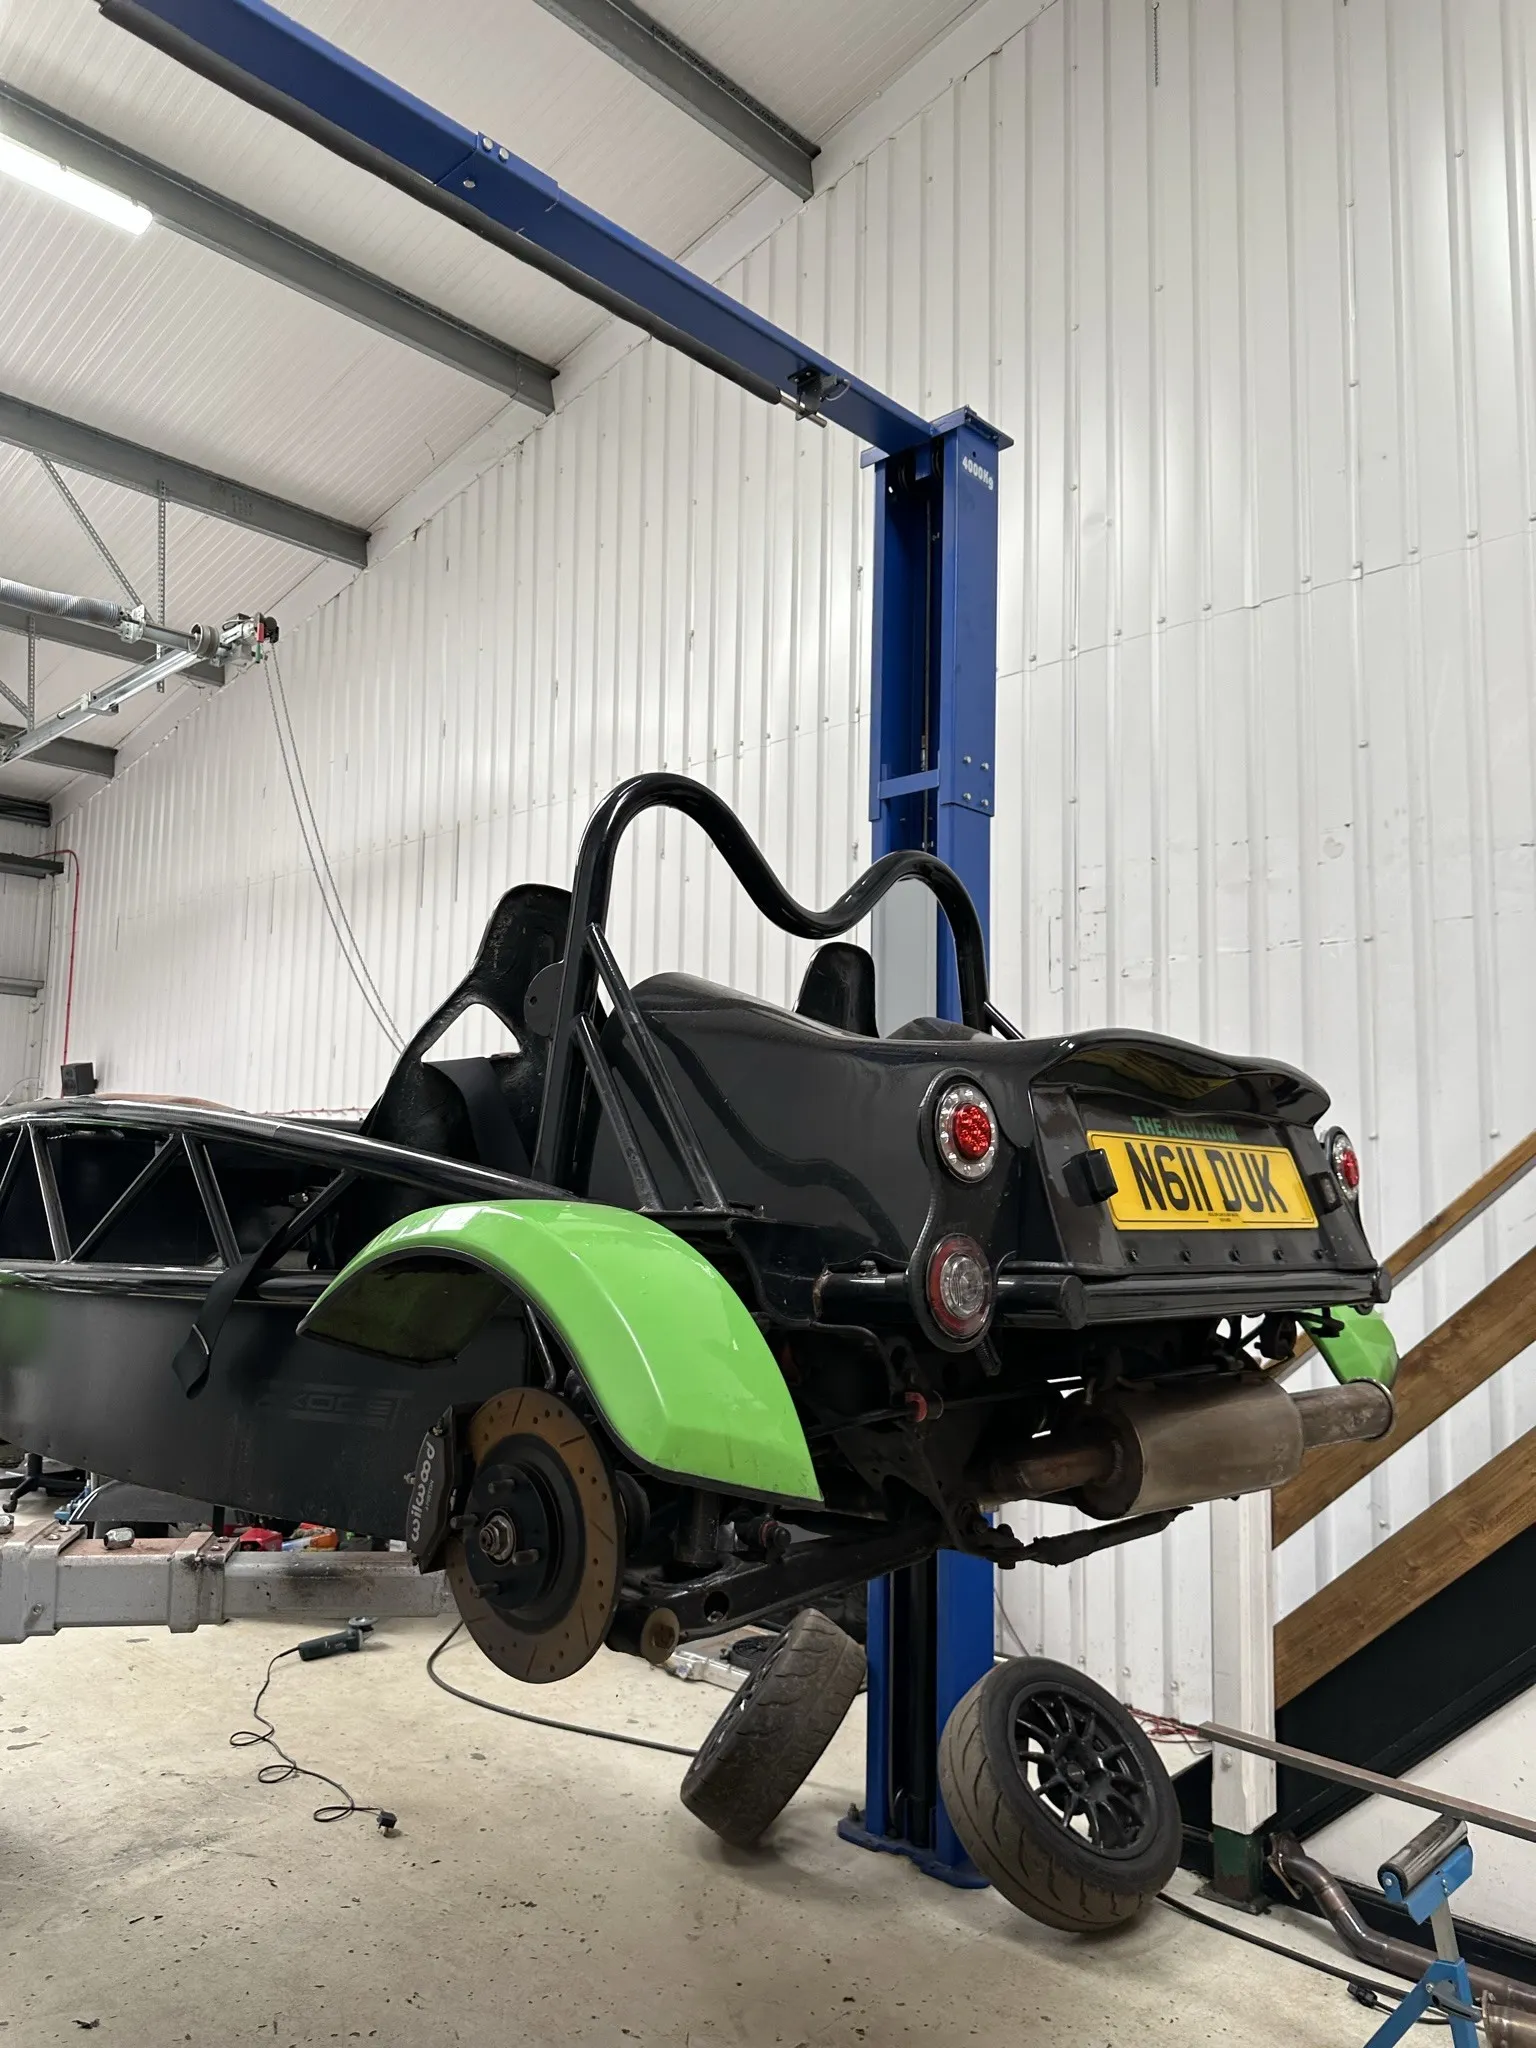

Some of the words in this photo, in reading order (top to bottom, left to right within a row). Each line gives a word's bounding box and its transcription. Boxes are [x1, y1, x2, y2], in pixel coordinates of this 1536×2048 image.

[1132, 1116, 1165, 1136] THE
[1167, 1118, 1200, 1139] ALDI
[1201, 1122, 1239, 1142] ATOM
[1124, 1141, 1214, 1211] N611
[1203, 1149, 1289, 1213] DUK
[411, 1441, 435, 1542] wilwood
